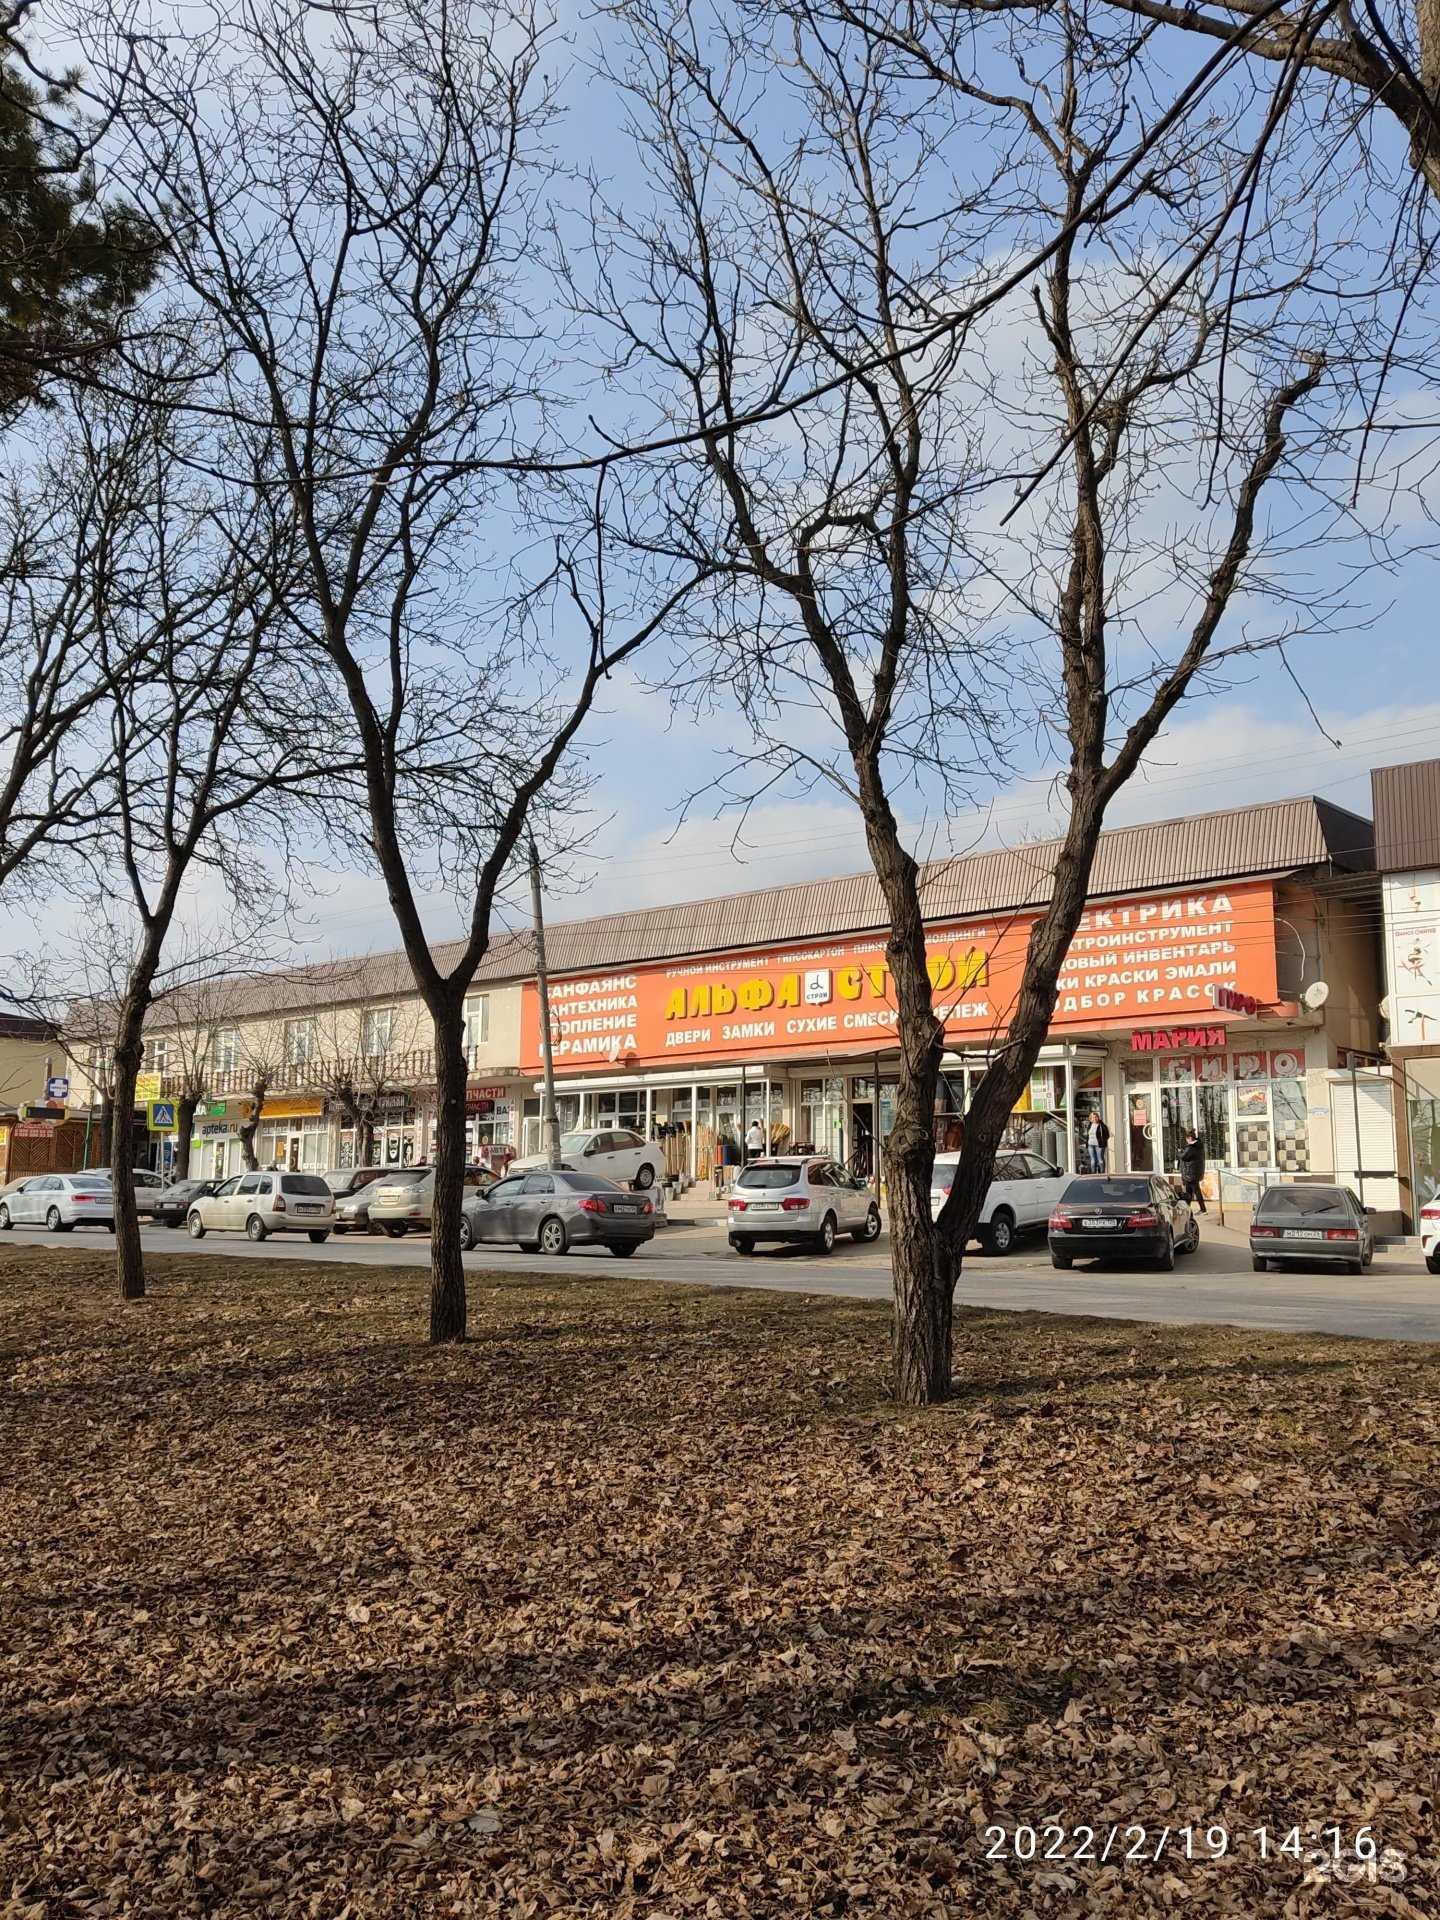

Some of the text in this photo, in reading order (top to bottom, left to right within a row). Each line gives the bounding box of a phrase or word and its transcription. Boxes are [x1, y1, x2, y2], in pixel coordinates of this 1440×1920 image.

[1076, 893, 1233, 931] ЕКТРИКА
[705, 957, 769, 974] ИНСТРУМЕНТ
[777, 945, 845, 965] ГИПСОКАРТОН
[1123, 941, 1236, 964] ИНВЕНТАРЬ
[664, 947, 989, 1020] АЛЬФА СТОЙ
[1085, 968, 1159, 989] КРАСКИ
[1165, 960, 1237, 980] ЭМАЛИ
[549, 995, 638, 1018] АНТЕХНИКА
[540, 1014, 637, 1036] ТОПЛЕНИЕ
[665, 1028, 711, 1047] ДВЕРИ
[722, 1021, 775, 1039] ЗАМКИ
[787, 1015, 837, 1034] СУХИЕ
[1131, 1026, 1226, 1051] МАРИЯ
[201, 1120, 238, 1136] apteka.ru
